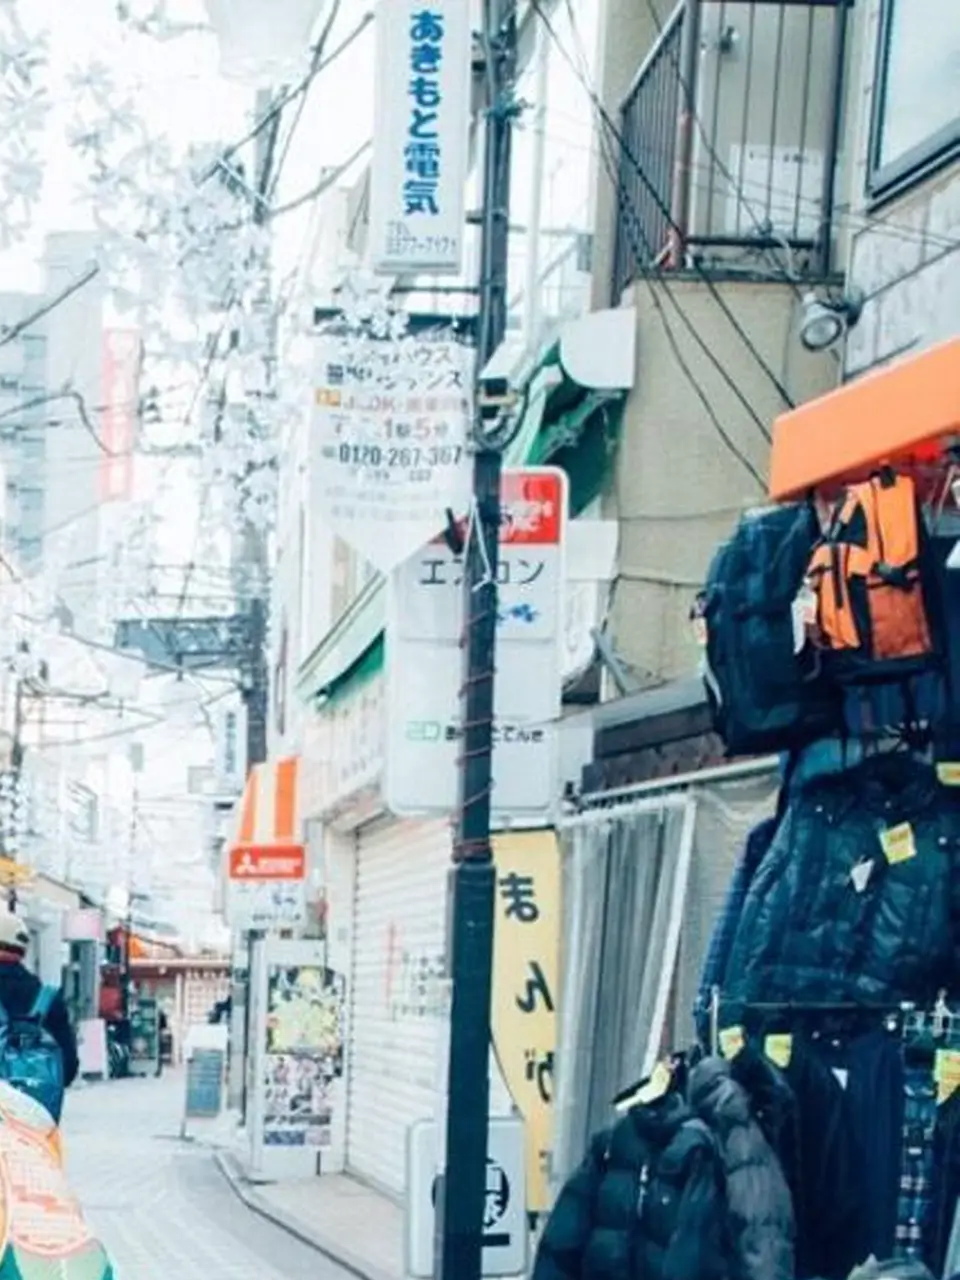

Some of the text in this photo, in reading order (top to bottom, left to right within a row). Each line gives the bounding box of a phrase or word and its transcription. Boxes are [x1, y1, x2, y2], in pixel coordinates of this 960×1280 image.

[402, 9, 445, 216] あきもと電気
